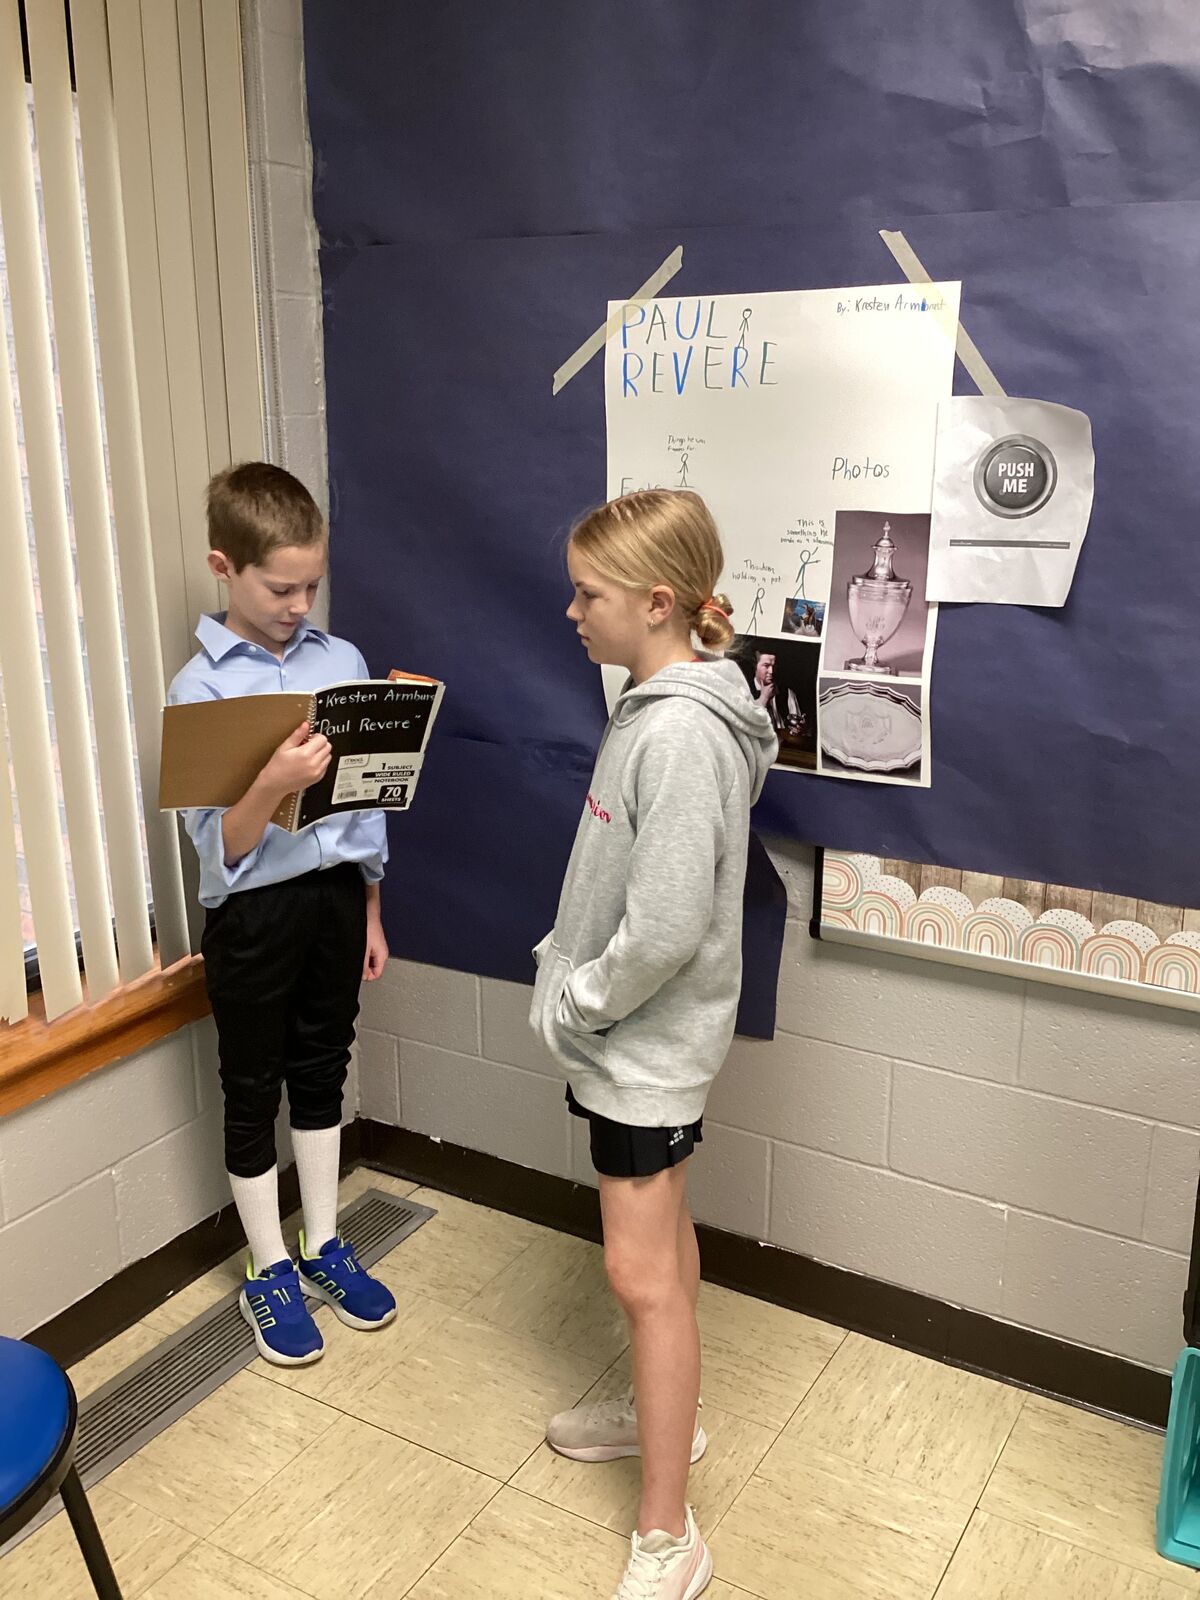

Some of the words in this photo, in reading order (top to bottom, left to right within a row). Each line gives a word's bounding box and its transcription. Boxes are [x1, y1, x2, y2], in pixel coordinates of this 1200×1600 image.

[622, 300, 728, 349] PAUL
[622, 341, 778, 398] REVERE
[831, 457, 890, 480] Photos
[998, 462, 1035, 478] PUSH
[1002, 478, 1028, 493] ME
[797, 519, 815, 529] This
[325, 691, 378, 708] Kresten
[384, 786, 402, 798] 70
